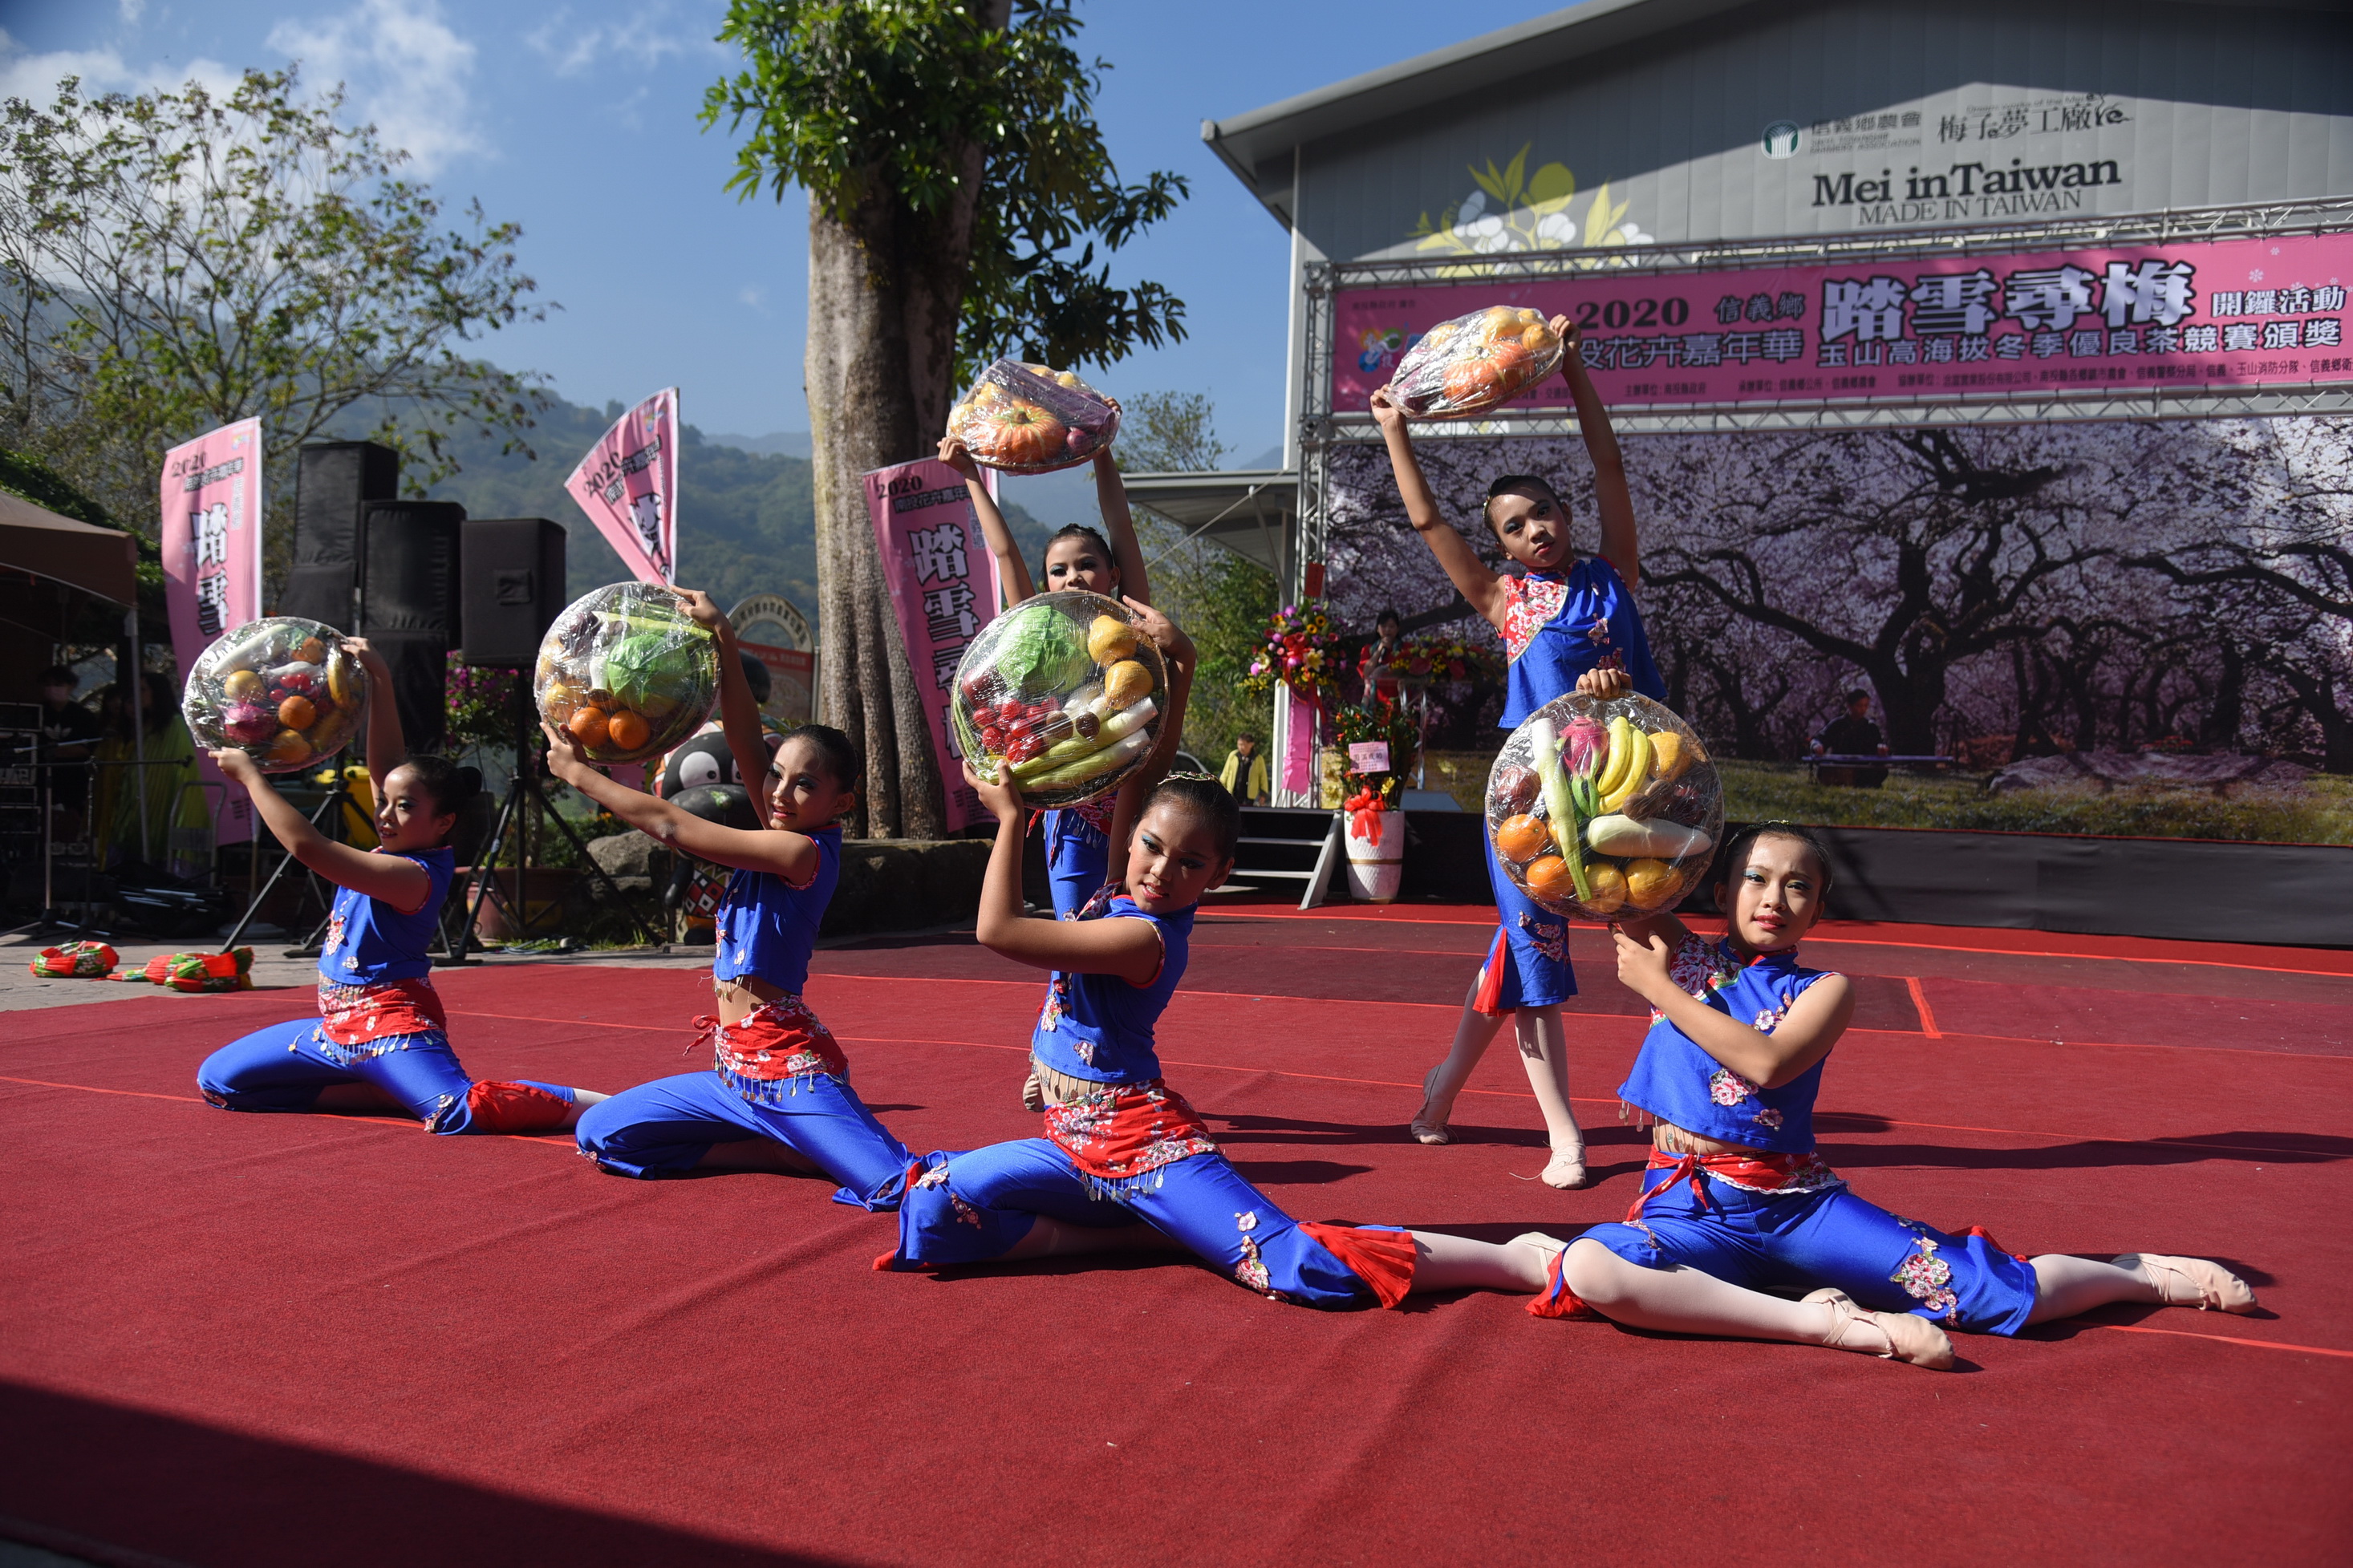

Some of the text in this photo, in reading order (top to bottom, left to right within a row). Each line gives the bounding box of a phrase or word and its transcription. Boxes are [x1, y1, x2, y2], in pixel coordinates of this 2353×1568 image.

[1811, 111, 1921, 136] 信義鄉農會
[1937, 102, 2092, 144] 梅子夢工廠
[1811, 167, 1893, 206] Mei
[1859, 189, 2082, 226] MADE IN TAIWAN
[1576, 291, 1806, 330] 2020 信義鄉
[1818, 260, 2197, 343] 踏雪尋梅
[2211, 286, 2346, 318] 開鑼活動
[1816, 318, 2342, 367] 玉山高海拔冬季優良茶競賽頒獎
[172, 451, 207, 477] 2020
[877, 476, 923, 500] 2020
